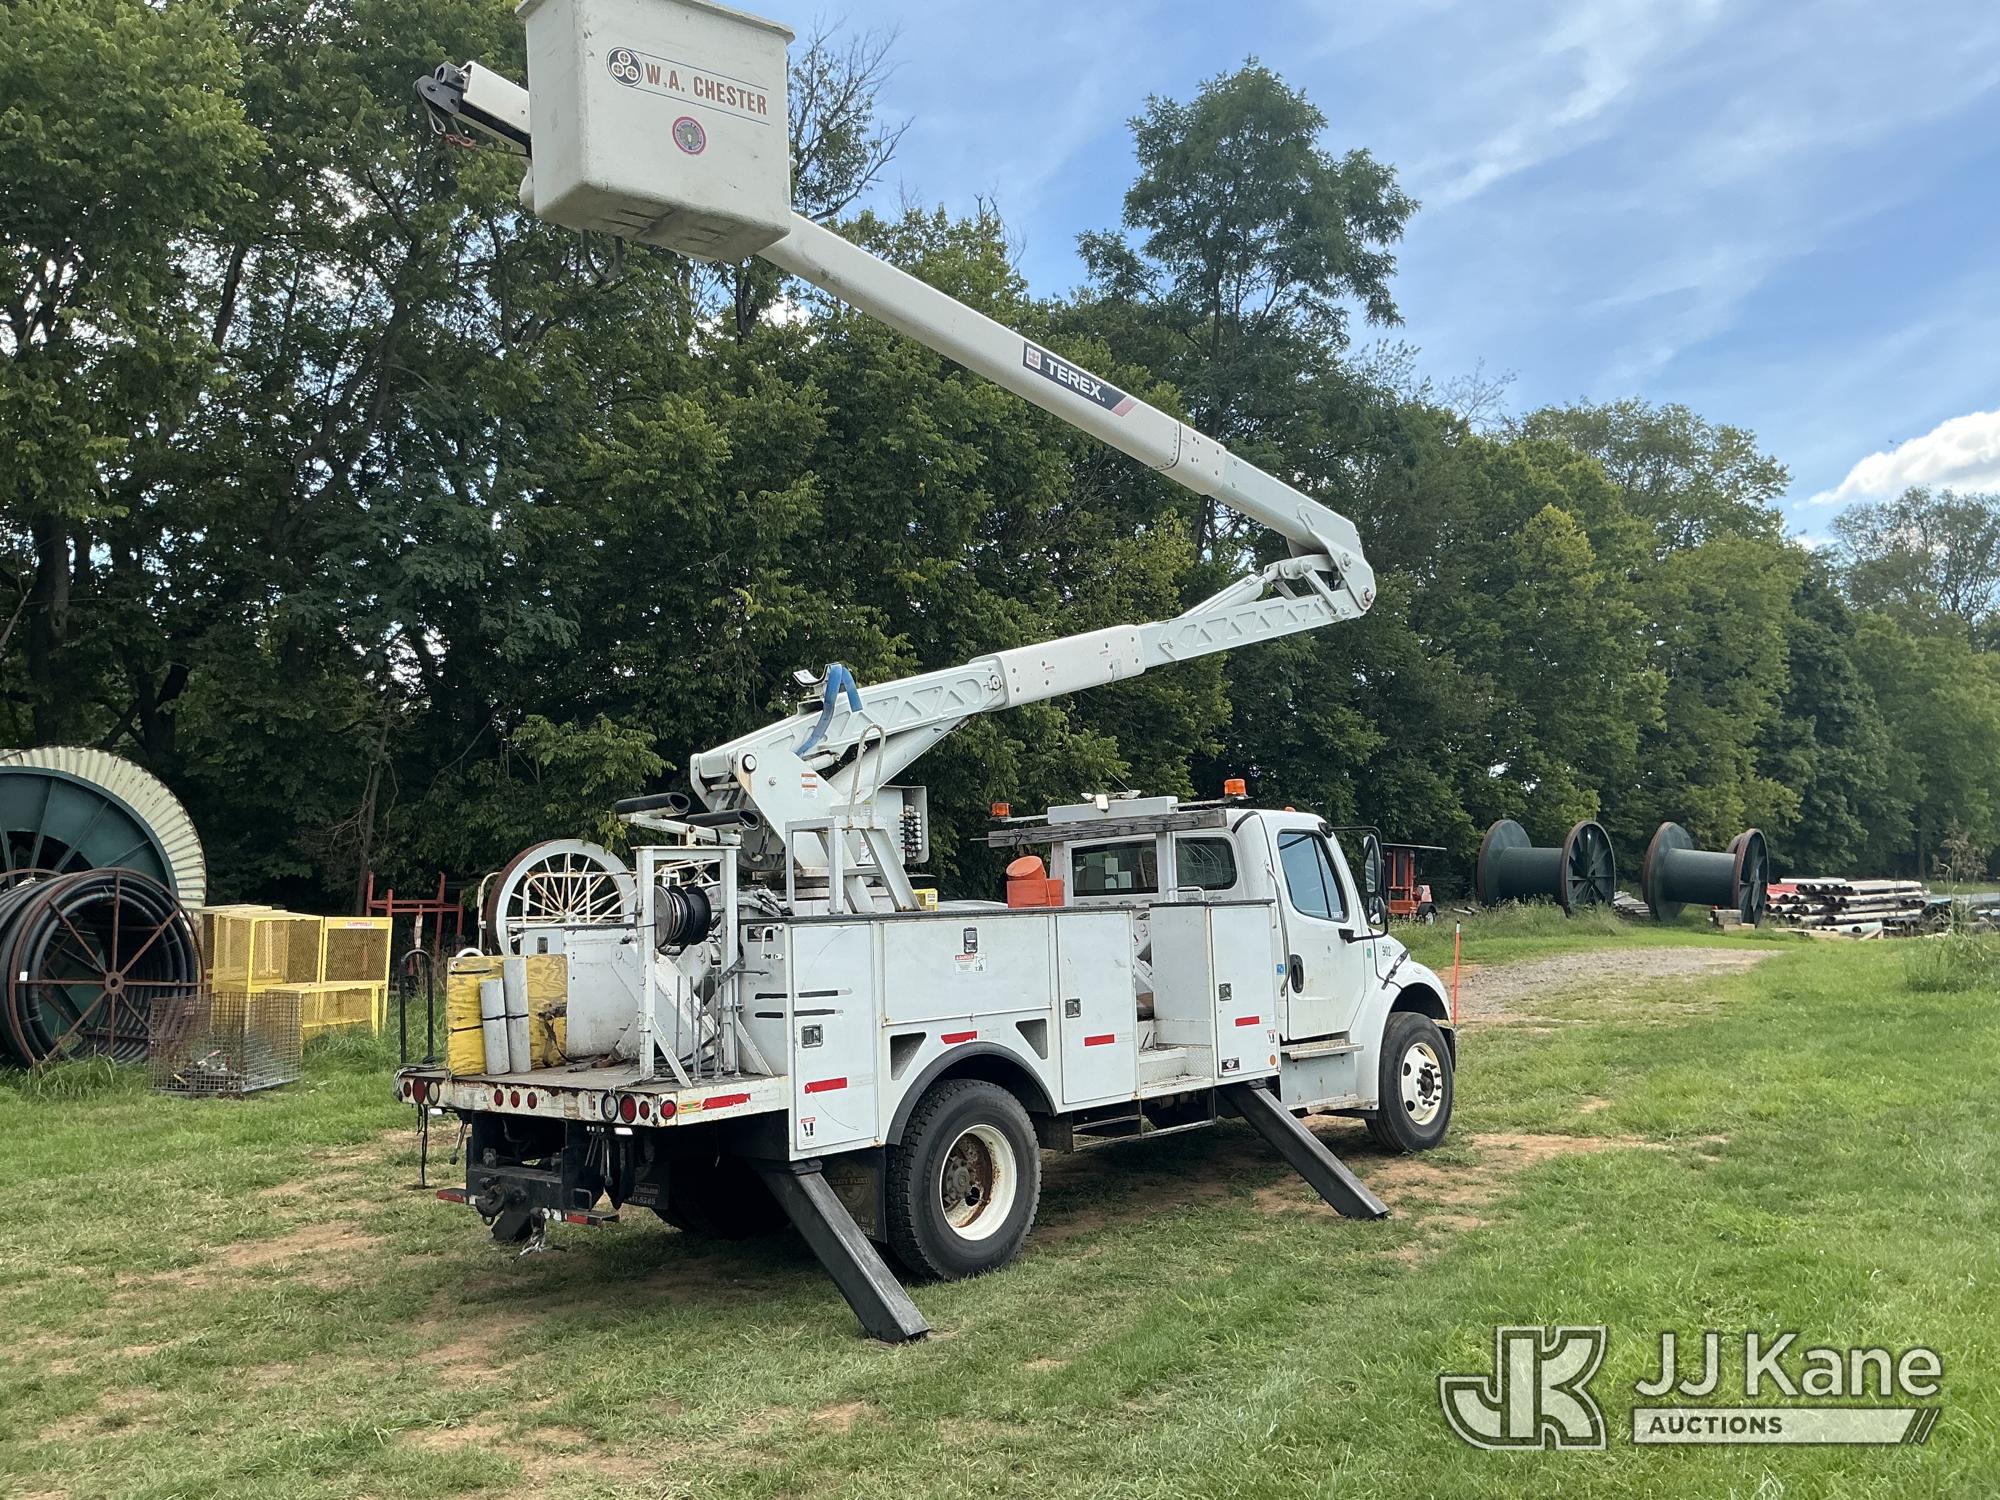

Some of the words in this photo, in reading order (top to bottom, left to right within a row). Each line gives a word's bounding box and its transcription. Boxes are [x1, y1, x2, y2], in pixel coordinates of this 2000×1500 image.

[645, 62, 685, 92] W.A.
[693, 76, 768, 116] CHESTER
[1382, 945, 1392, 957] 902
